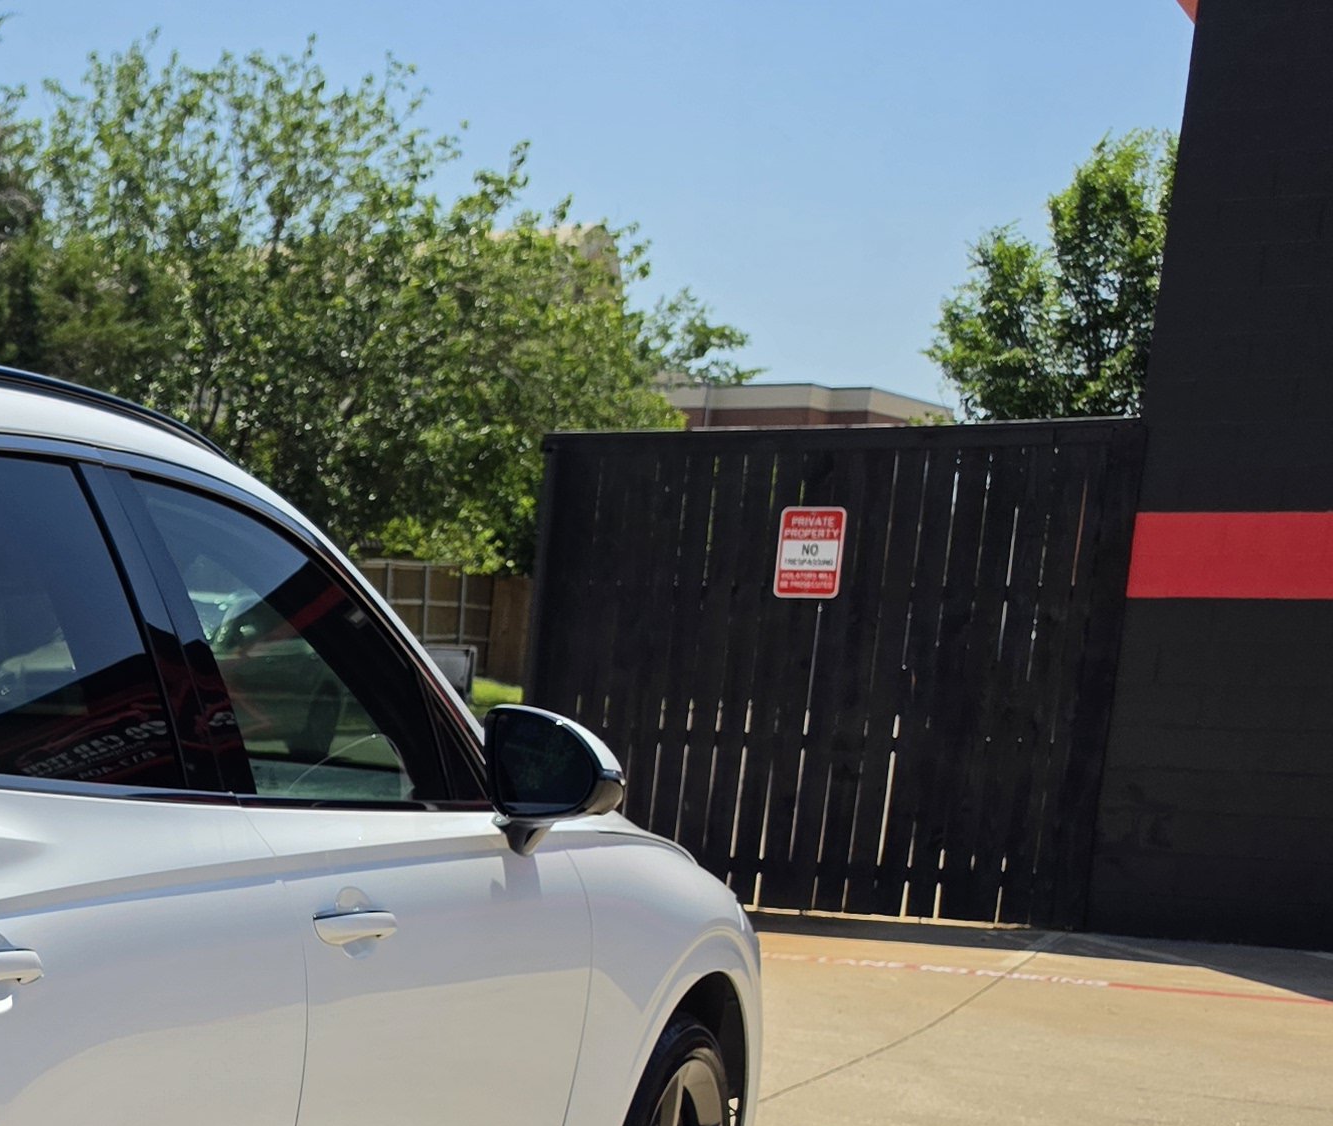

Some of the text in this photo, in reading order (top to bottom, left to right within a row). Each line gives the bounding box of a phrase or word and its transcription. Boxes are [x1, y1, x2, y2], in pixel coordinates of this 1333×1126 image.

[791, 515, 835, 527] PRIVATE
[783, 527, 841, 540] PROPERTY
[801, 543, 819, 557] NO
